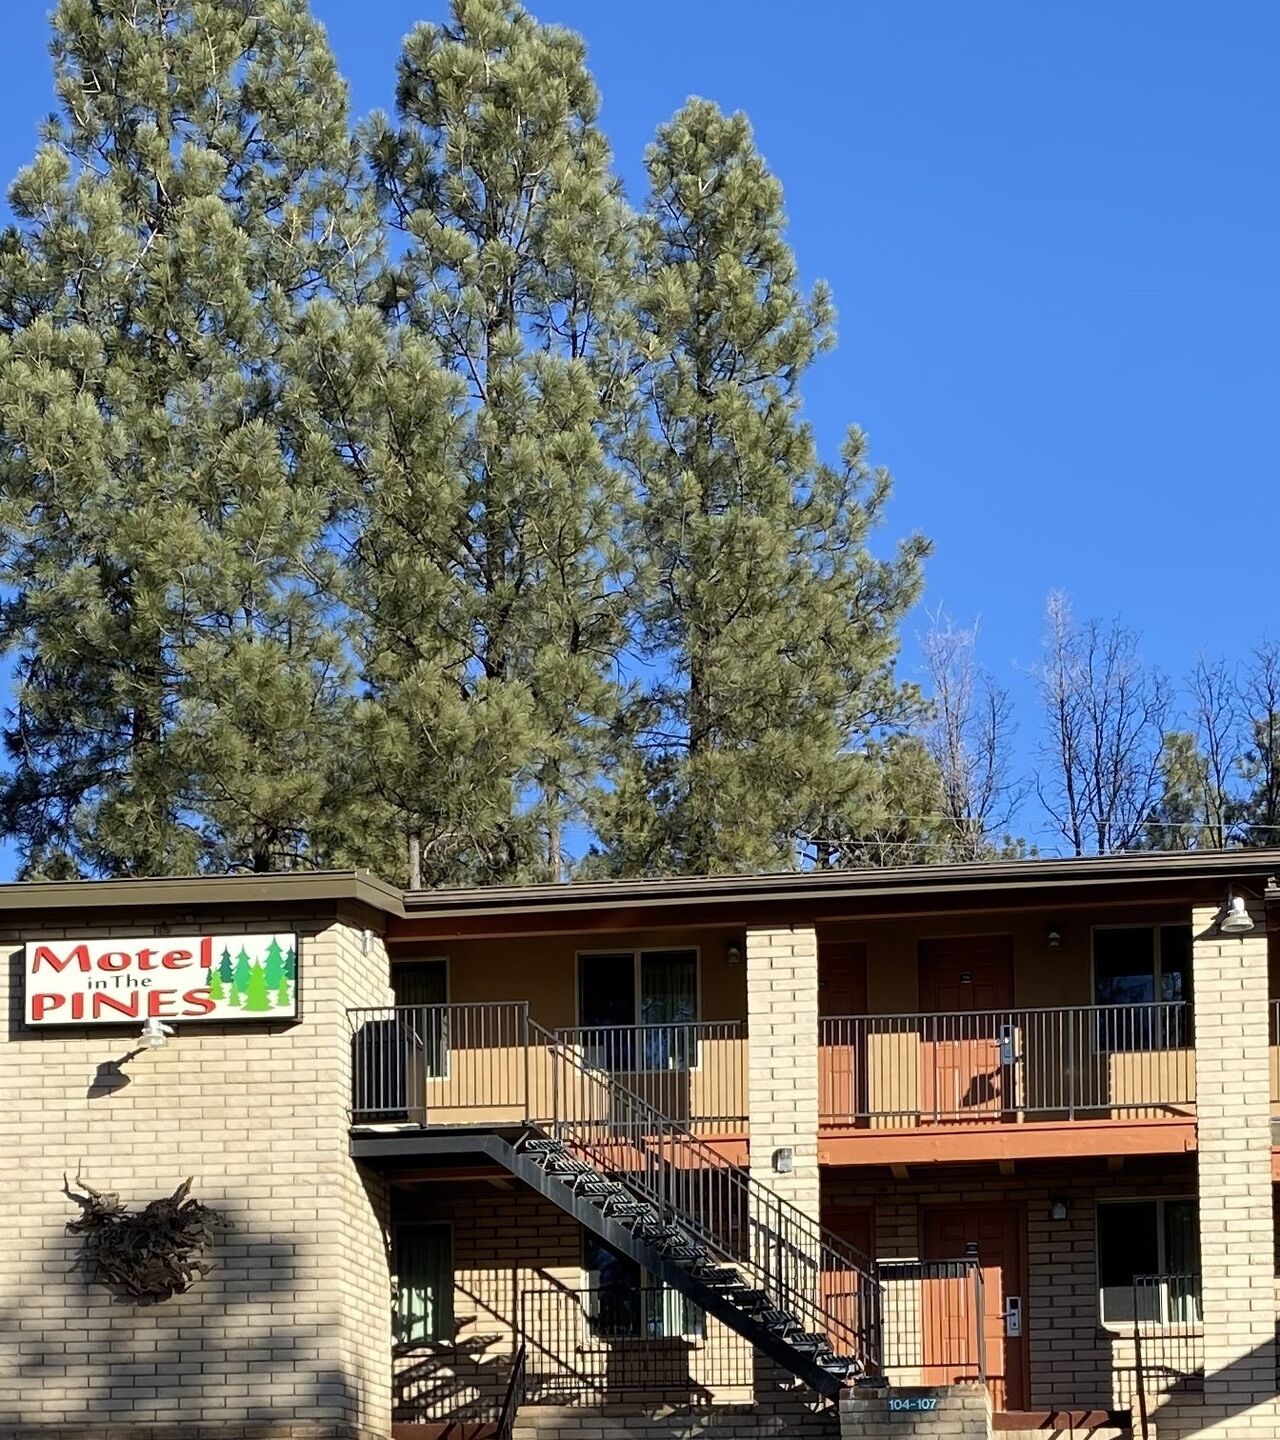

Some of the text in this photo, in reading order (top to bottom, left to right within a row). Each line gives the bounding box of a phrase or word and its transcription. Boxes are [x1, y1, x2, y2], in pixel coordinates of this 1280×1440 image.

[32, 937, 212, 973] Motel
[32, 988, 216, 1020] PINES
[889, 1399, 936, 1410] 104-107
